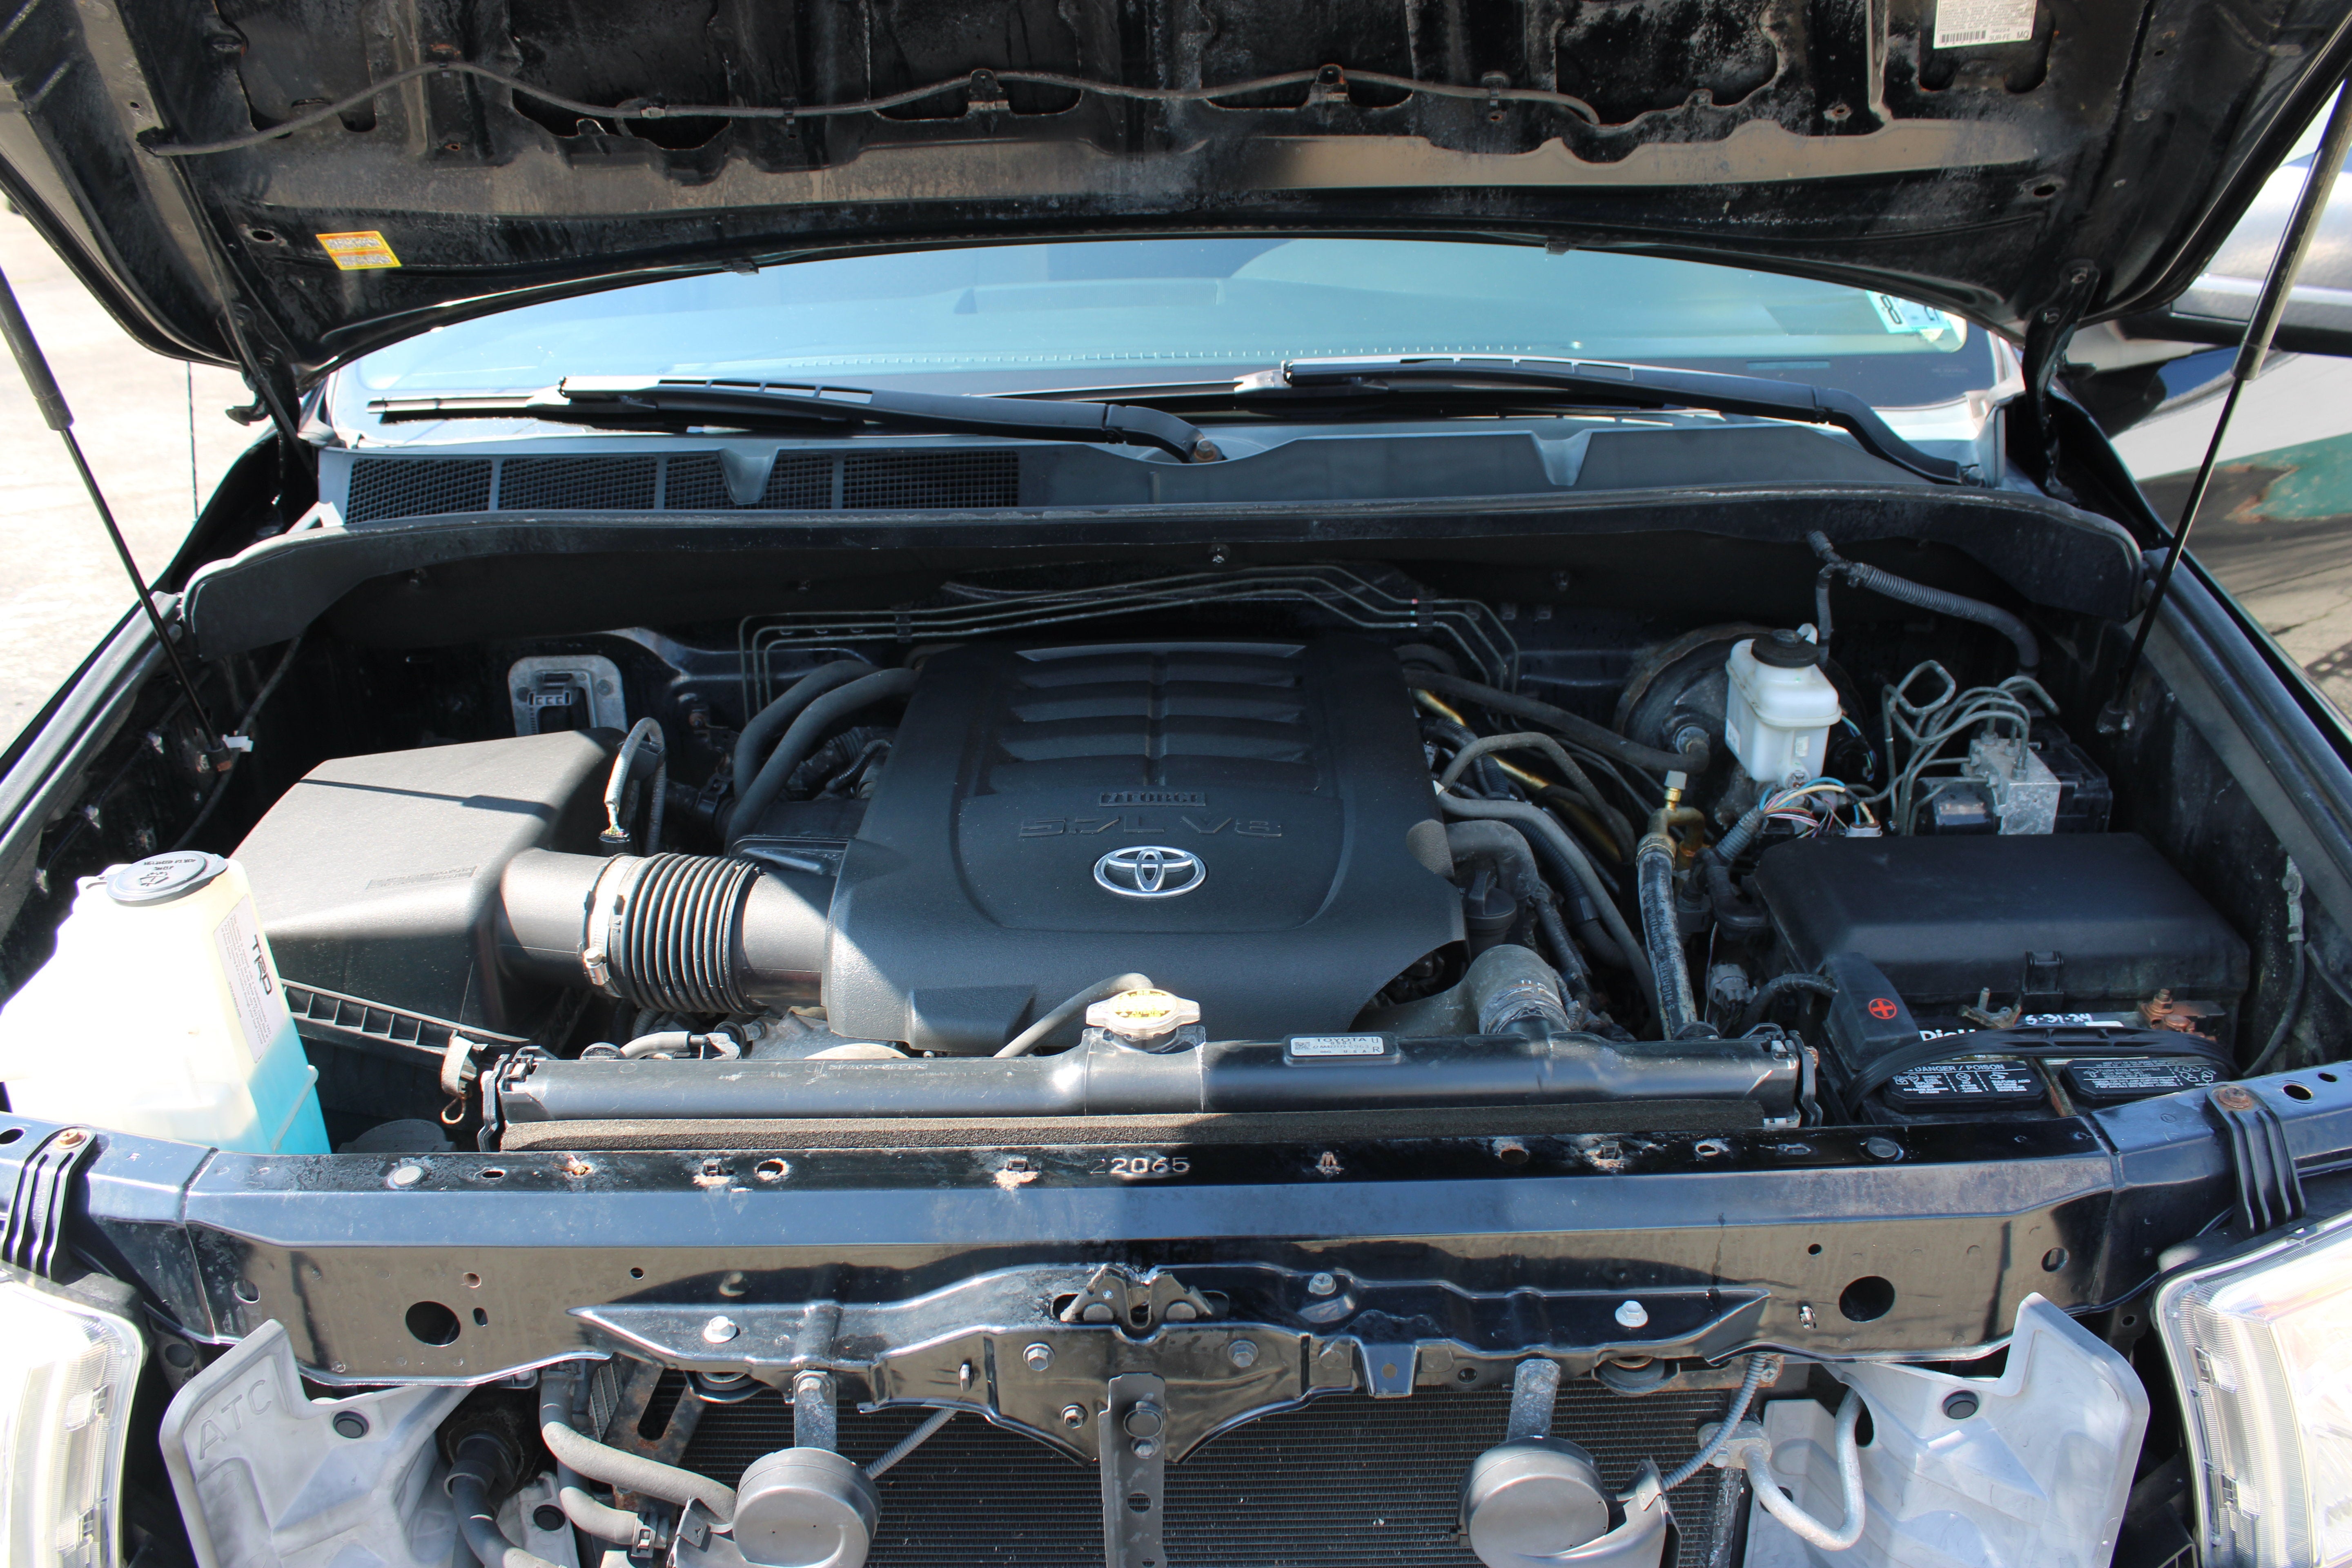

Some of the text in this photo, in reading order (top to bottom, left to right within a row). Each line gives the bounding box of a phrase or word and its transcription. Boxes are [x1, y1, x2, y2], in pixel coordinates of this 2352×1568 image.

[1181, 815, 1282, 837] V8
[252, 934, 273, 996] TRD
[199, 1379, 272, 1461] ATC
